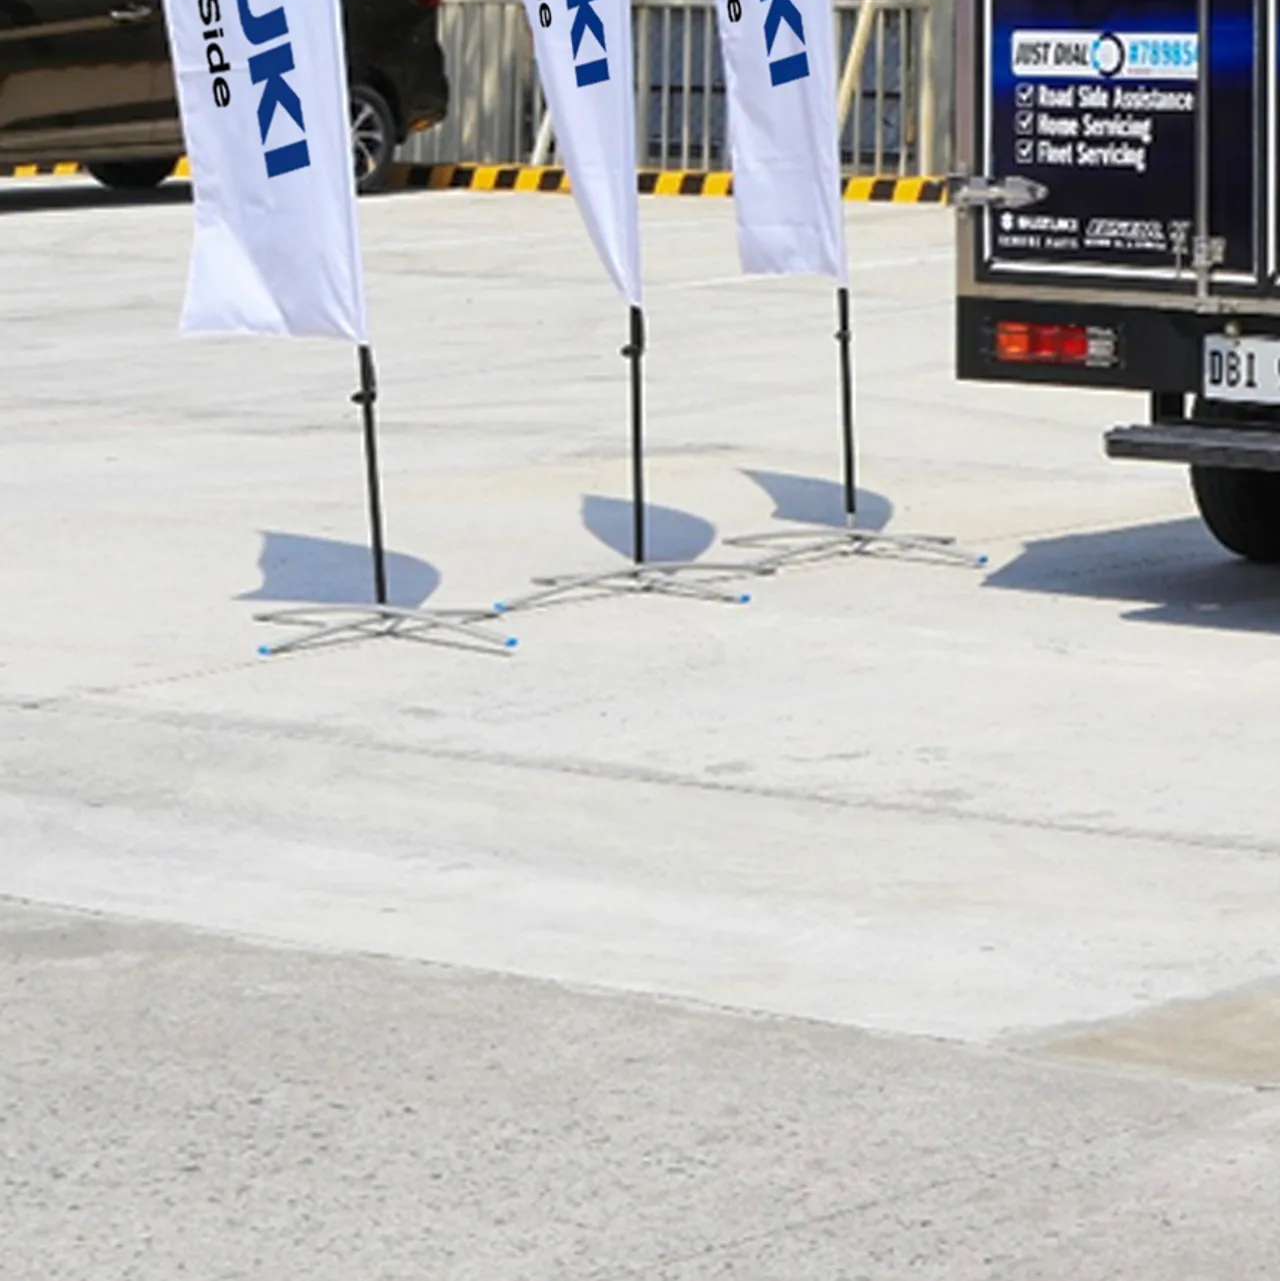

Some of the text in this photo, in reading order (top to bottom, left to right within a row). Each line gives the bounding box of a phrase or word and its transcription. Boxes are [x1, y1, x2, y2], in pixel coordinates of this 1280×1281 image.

[1015, 42, 1051, 66] JUST
[1054, 42, 1089, 66] DIAL
[1037, 83, 1194, 111] Road Side Assistance
[1037, 112, 1152, 144] Home Servicing
[1037, 139, 1146, 172] Fleet Servicing
